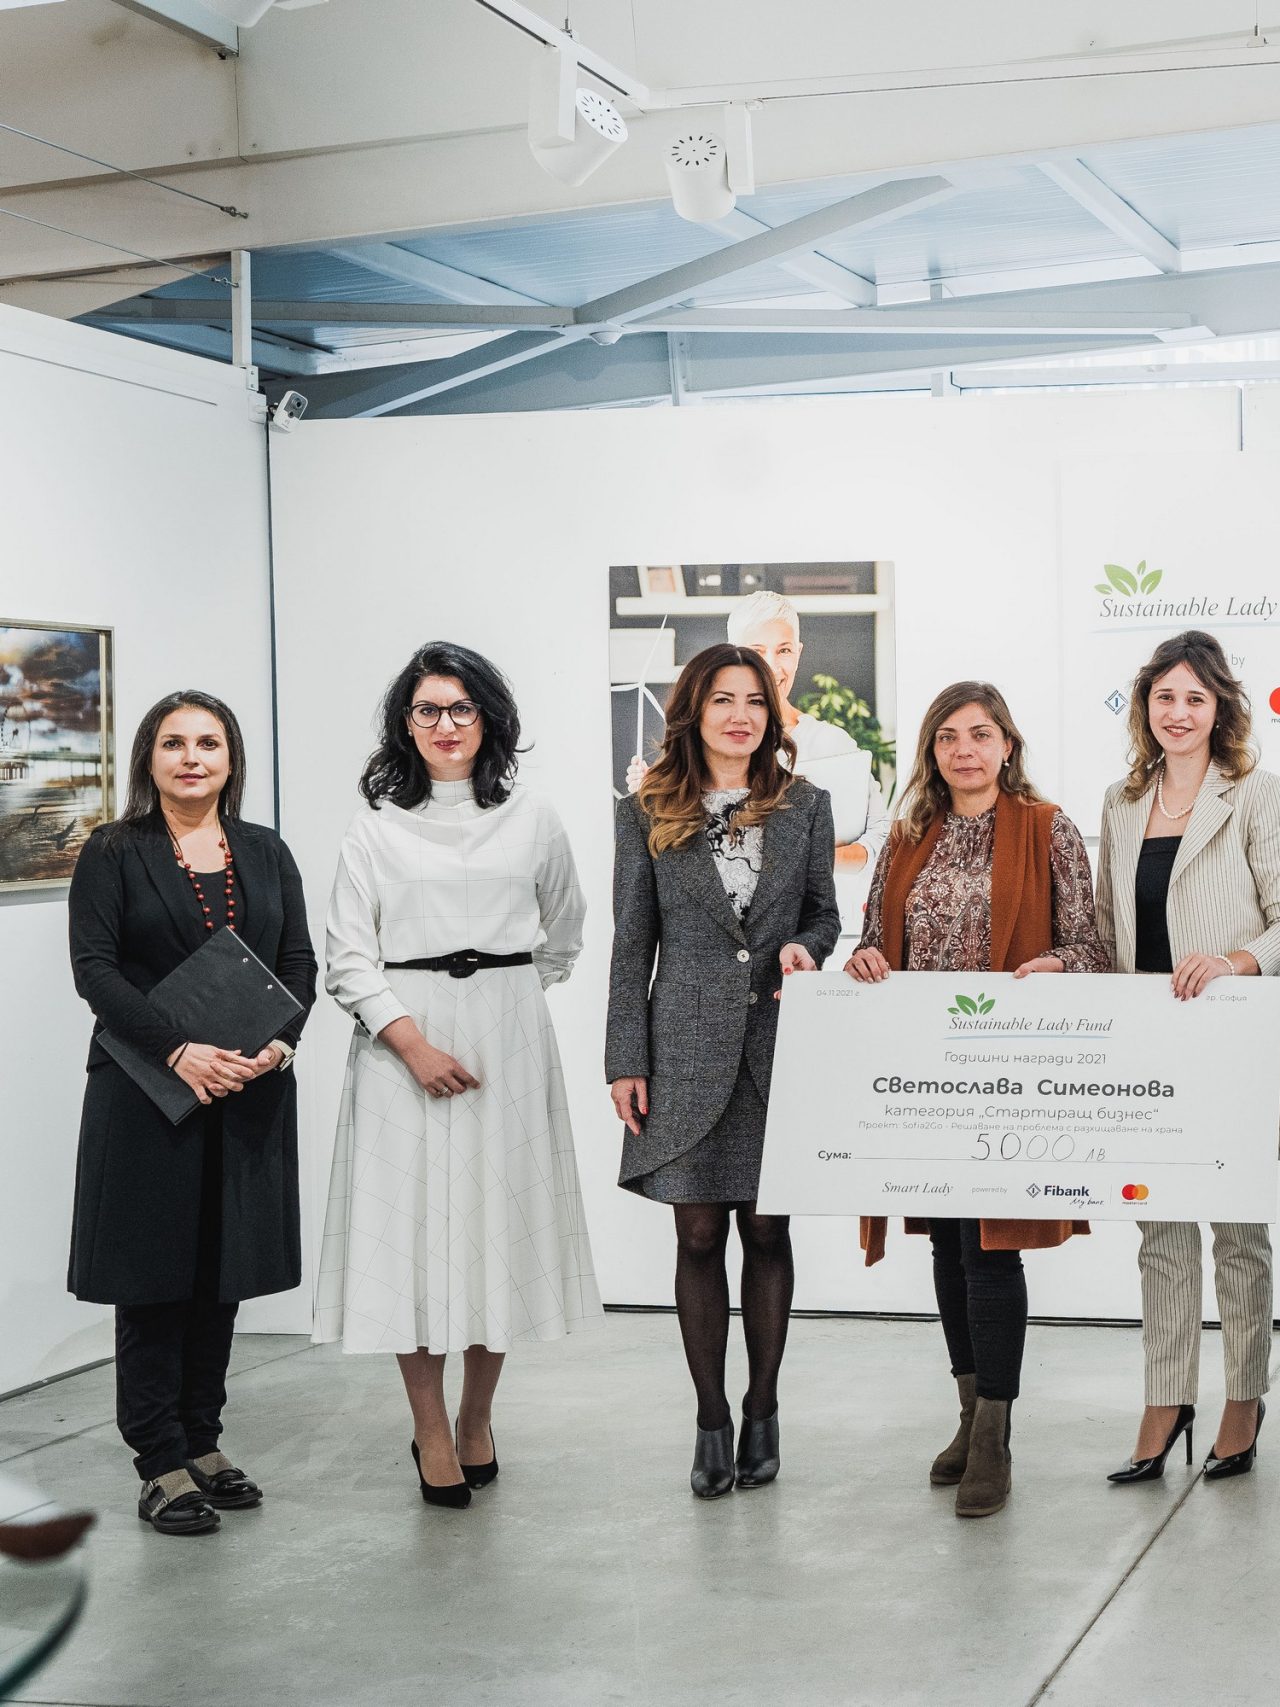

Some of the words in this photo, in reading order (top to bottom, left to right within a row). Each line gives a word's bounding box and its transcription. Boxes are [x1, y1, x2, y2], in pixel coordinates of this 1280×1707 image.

[1099, 597, 1219, 618] Sustainable
[1226, 595, 1278, 621] Lady
[1231, 653, 1246, 669] by
[1219, 994, 1248, 1003] София
[949, 1016, 1033, 1031] Sustainable
[1037, 1018, 1073, 1034] Lady
[1076, 1018, 1113, 1032] Fund
[944, 1051, 1010, 1065] Годишни
[1014, 1054, 1074, 1066] награди
[1077, 1053, 1107, 1065] 2021
[872, 1076, 1024, 1095] Светослава
[1037, 1078, 1175, 1098] Симеонова
[885, 1104, 975, 1120] категория
[979, 1105, 1094, 1121] „Стартиращ
[858, 1120, 900, 1131] Проект:
[902, 1121, 944, 1130] Sofia2Go
[951, 1121, 1001, 1131] Решаване
[1016, 1124, 1064, 1133] проблема
[1073, 1124, 1139, 1134] разхищаване
[1155, 1127, 1183, 1135] храна
[970, 1132, 1075, 1161] 5000
[817, 1150, 852, 1161] Сума:
[882, 1181, 919, 1193] Smart
[922, 1182, 954, 1195] Lady
[971, 1187, 1000, 1195] powered
[1044, 1185, 1090, 1197] Fibank
